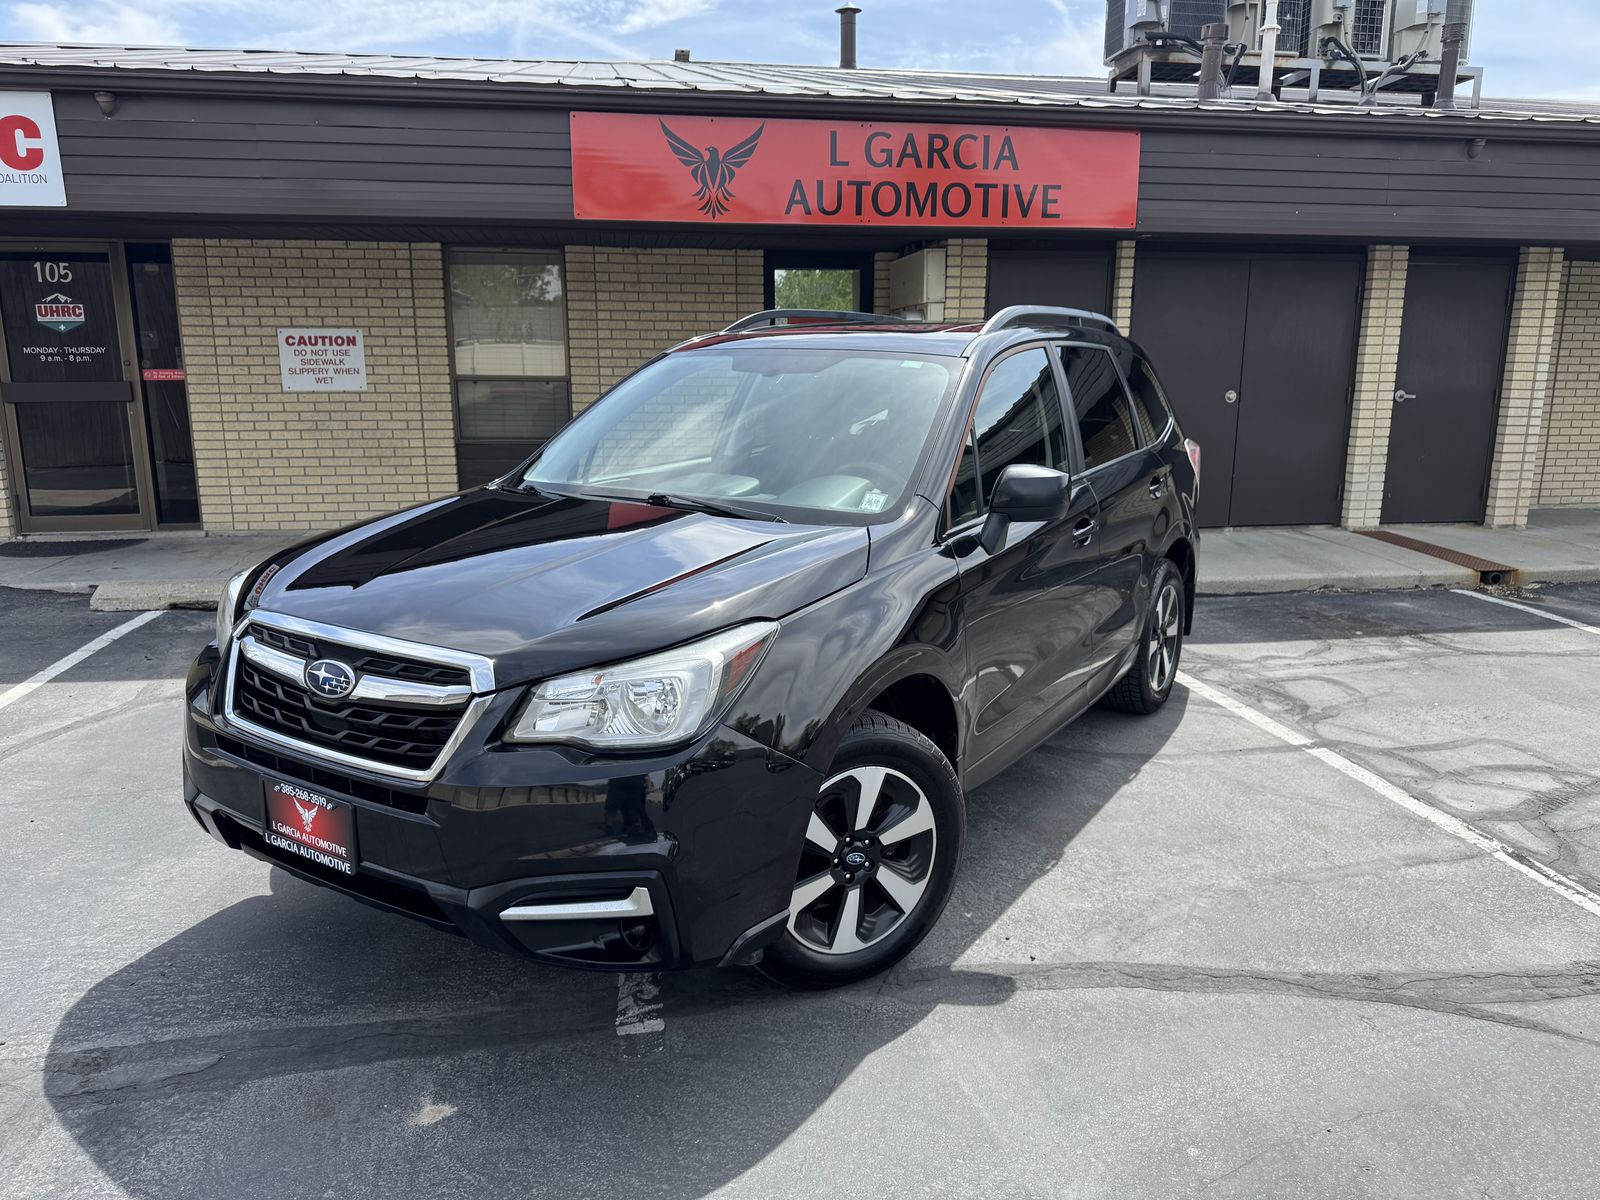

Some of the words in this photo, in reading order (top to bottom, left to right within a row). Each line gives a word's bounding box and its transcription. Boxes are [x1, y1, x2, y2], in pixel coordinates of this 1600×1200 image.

[829, 130, 850, 168] L
[864, 130, 1020, 171] GARCIA
[784, 179, 1062, 219] AUTOMOTIVE
[33, 261, 73, 283] 105
[37, 305, 83, 318] UHRC
[284, 335, 357, 347] CAUTION
[23, 346, 58, 354] MONDAY
[64, 346, 106, 354] THURSDAY
[293, 349, 307, 357] DO
[310, 349, 329, 357] NOT
[332, 349, 351, 357] USE
[300, 358, 346, 366] SIDEWALK
[288, 367, 330, 375] SLIPPERY
[333, 367, 360, 375] WHEN
[314, 376, 334, 384] WET
[280, 783, 327, 808] 385-268-3519
[272, 820, 277, 830] L
[277, 822, 301, 839] GARCIA
[302, 832, 347, 857] AUTOMOTIVE
[265, 832, 271, 843] L
[271, 834, 299, 855] GARCIA
[299, 845, 351, 875] AUTOMOTIVE
